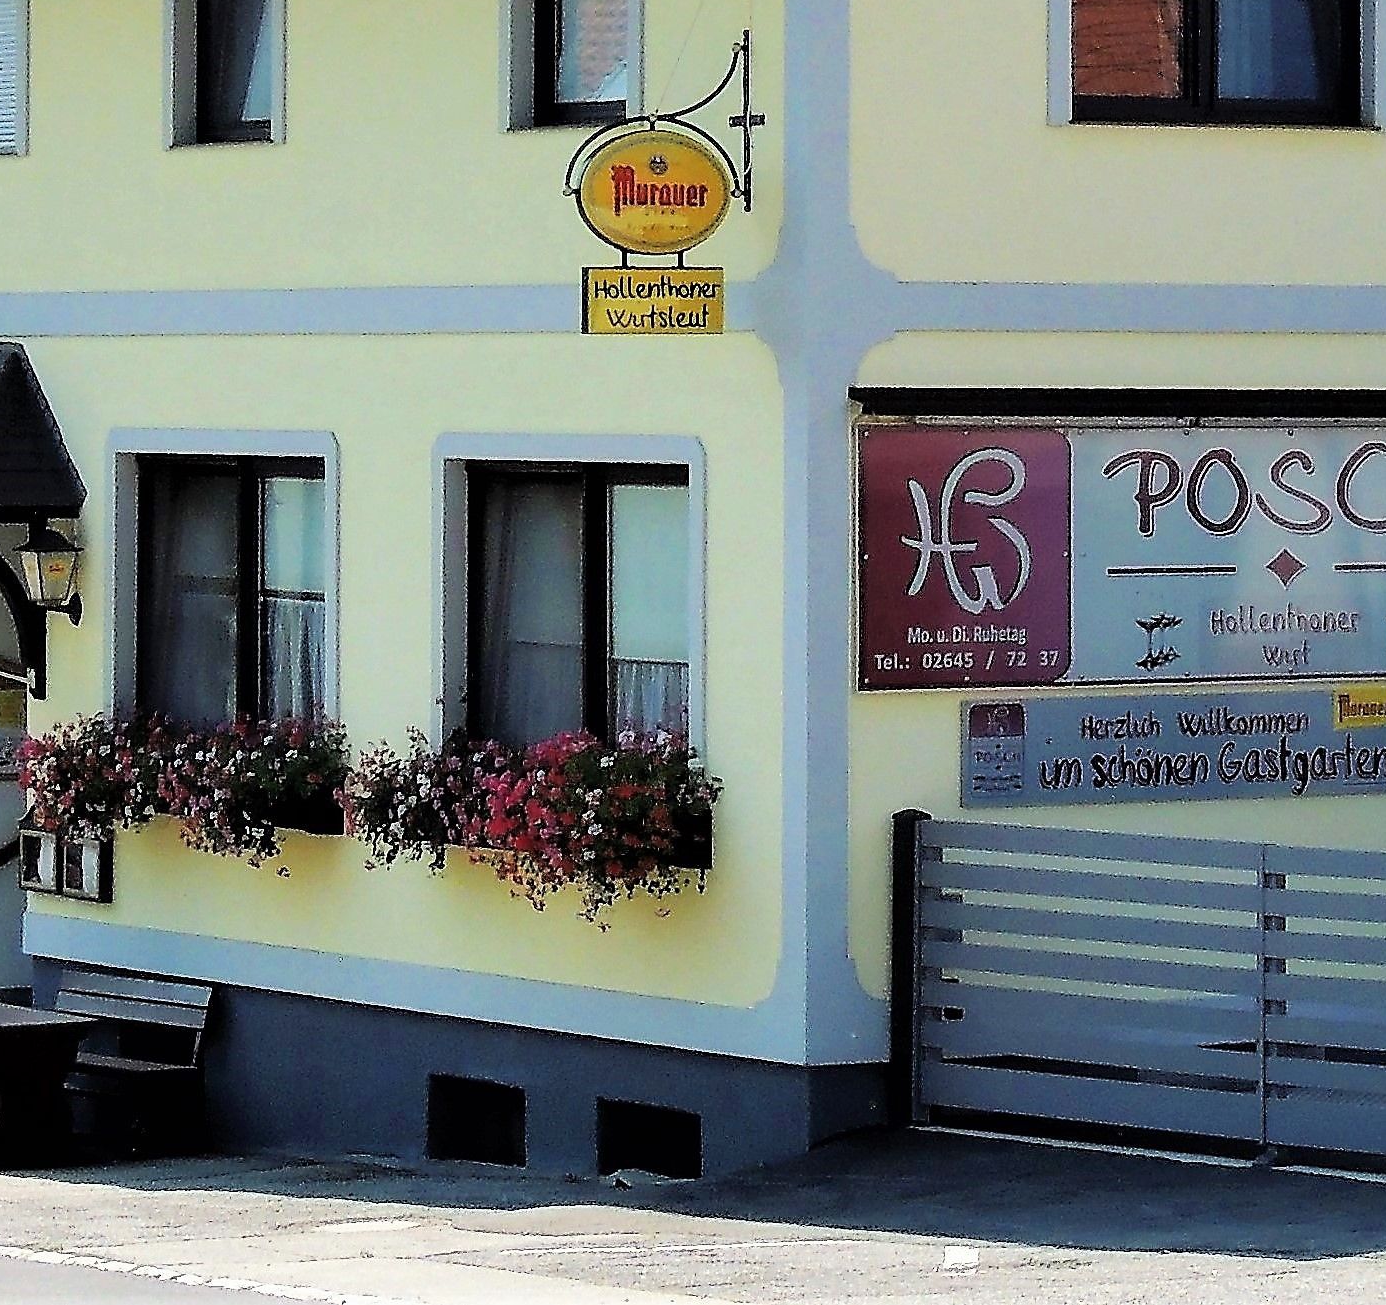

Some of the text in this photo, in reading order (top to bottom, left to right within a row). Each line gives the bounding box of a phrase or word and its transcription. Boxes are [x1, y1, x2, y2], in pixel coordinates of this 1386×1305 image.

[610, 164, 710, 217] Murauer
[594, 274, 722, 300] Hollenthoner
[907, 624, 1027, 645] Mo. u. Di. Ruhetag
[874, 653, 911, 670] Tel.:
[922, 652, 974, 669] 02645
[1006, 651, 1027, 667] 72
[1039, 650, 1059, 666] 37
[1081, 710, 1162, 740] Herzlich
[1090, 743, 1210, 790] schönen
